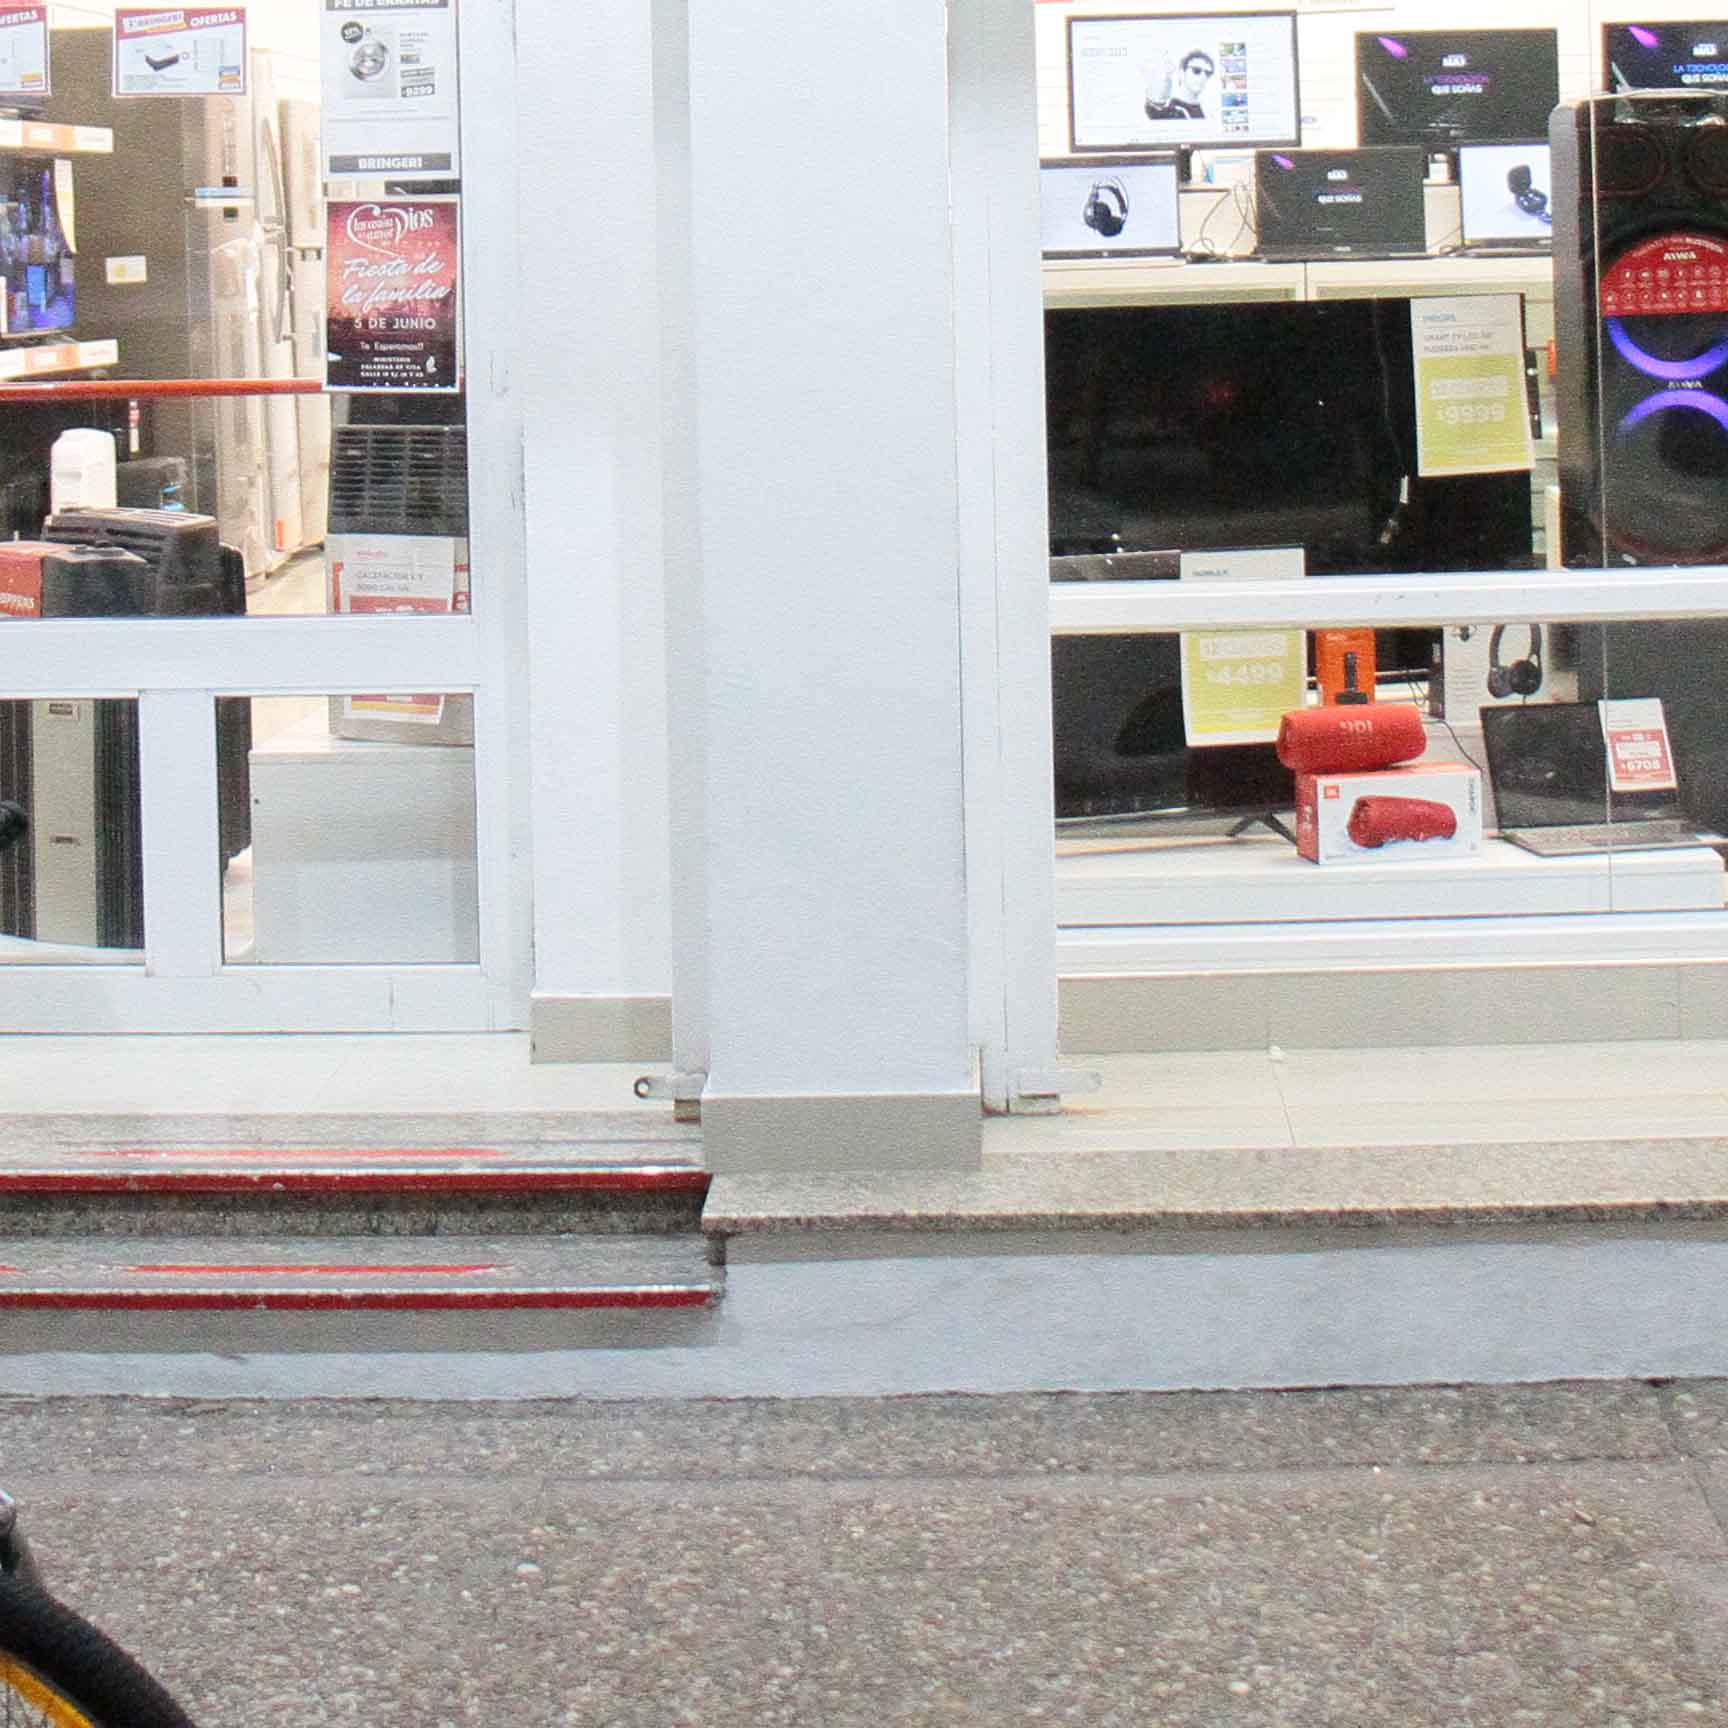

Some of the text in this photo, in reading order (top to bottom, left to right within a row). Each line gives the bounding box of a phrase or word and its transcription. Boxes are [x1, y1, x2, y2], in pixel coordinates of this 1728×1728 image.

[189, 10, 238, 28] OFERTAS
[342, 252, 447, 280] Fiesta de
[341, 279, 452, 313] la familia
[353, 317, 437, 330] 5 DE JUNIO
